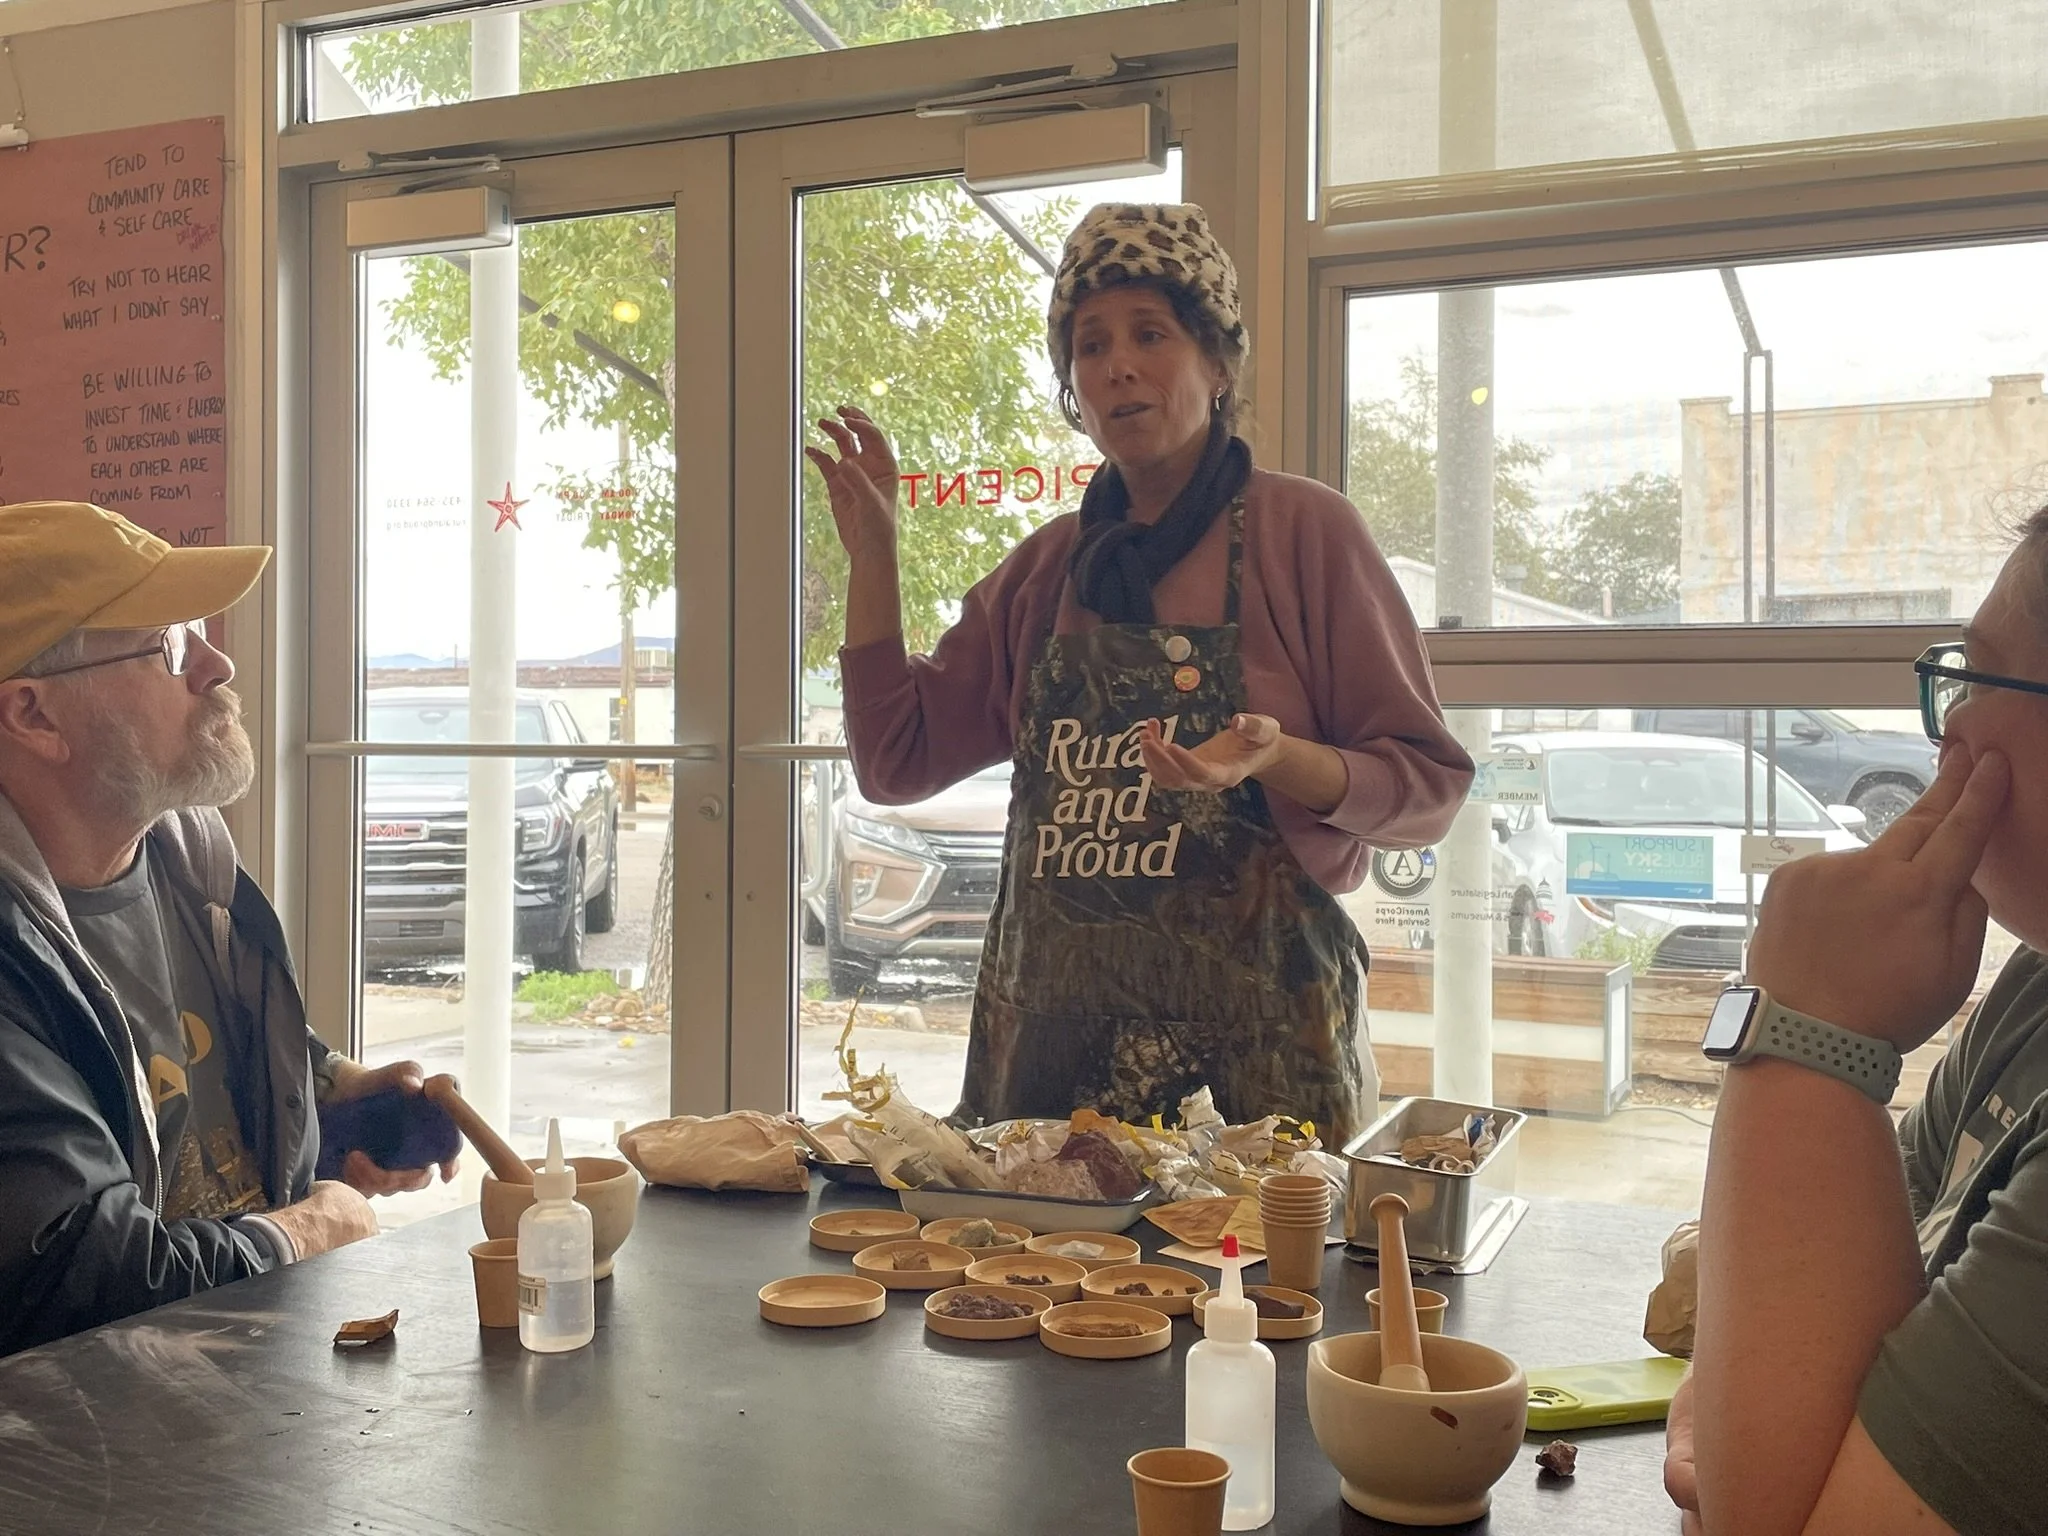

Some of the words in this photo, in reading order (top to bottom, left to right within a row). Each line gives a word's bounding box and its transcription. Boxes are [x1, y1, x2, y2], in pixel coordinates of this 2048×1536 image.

[104, 154, 146, 179] TEND
[162, 144, 184, 165] TO
[88, 182, 165, 215] COMMUNITY
[173, 178, 210, 201] CARE
[113, 214, 146, 237] SELF
[152, 207, 193, 231] CARE
[0, 226, 50, 272] R?
[68, 276, 95, 298] TRY
[106, 268, 136, 292] NOT
[141, 268, 160, 284] TO
[167, 263, 212, 283] HEAR
[63, 307, 102, 331] WHAT
[113, 306, 117, 324] I
[129, 295, 170, 321] DIDN'T
[180, 296, 209, 317] SAY
[82, 372, 104, 399] BE
[114, 365, 187, 392] WILLING
[194, 361, 212, 381] TO
[85, 406, 130, 430] INVEST
[139, 402, 172, 425] TIME
[187, 396, 226, 418] ENERGY
[83, 435, 97, 454] TO
[106, 430, 180, 453] UNDERSTAND
[187, 427, 223, 446] WHERE
[91, 463, 122, 479] EACH
[130, 458, 173, 478] OTHER
[179, 457, 209, 473] ARE
[90, 486, 142, 505] COMING
[150, 484, 191, 502] FROM
[180, 526, 215, 545] NOT
[1044, 714, 1180, 787] Rural
[1053, 772, 1152, 841] and
[366, 822, 423, 839] MC
[1031, 822, 1183, 879] Proud
[1987, 1094, 2017, 1130] RE
